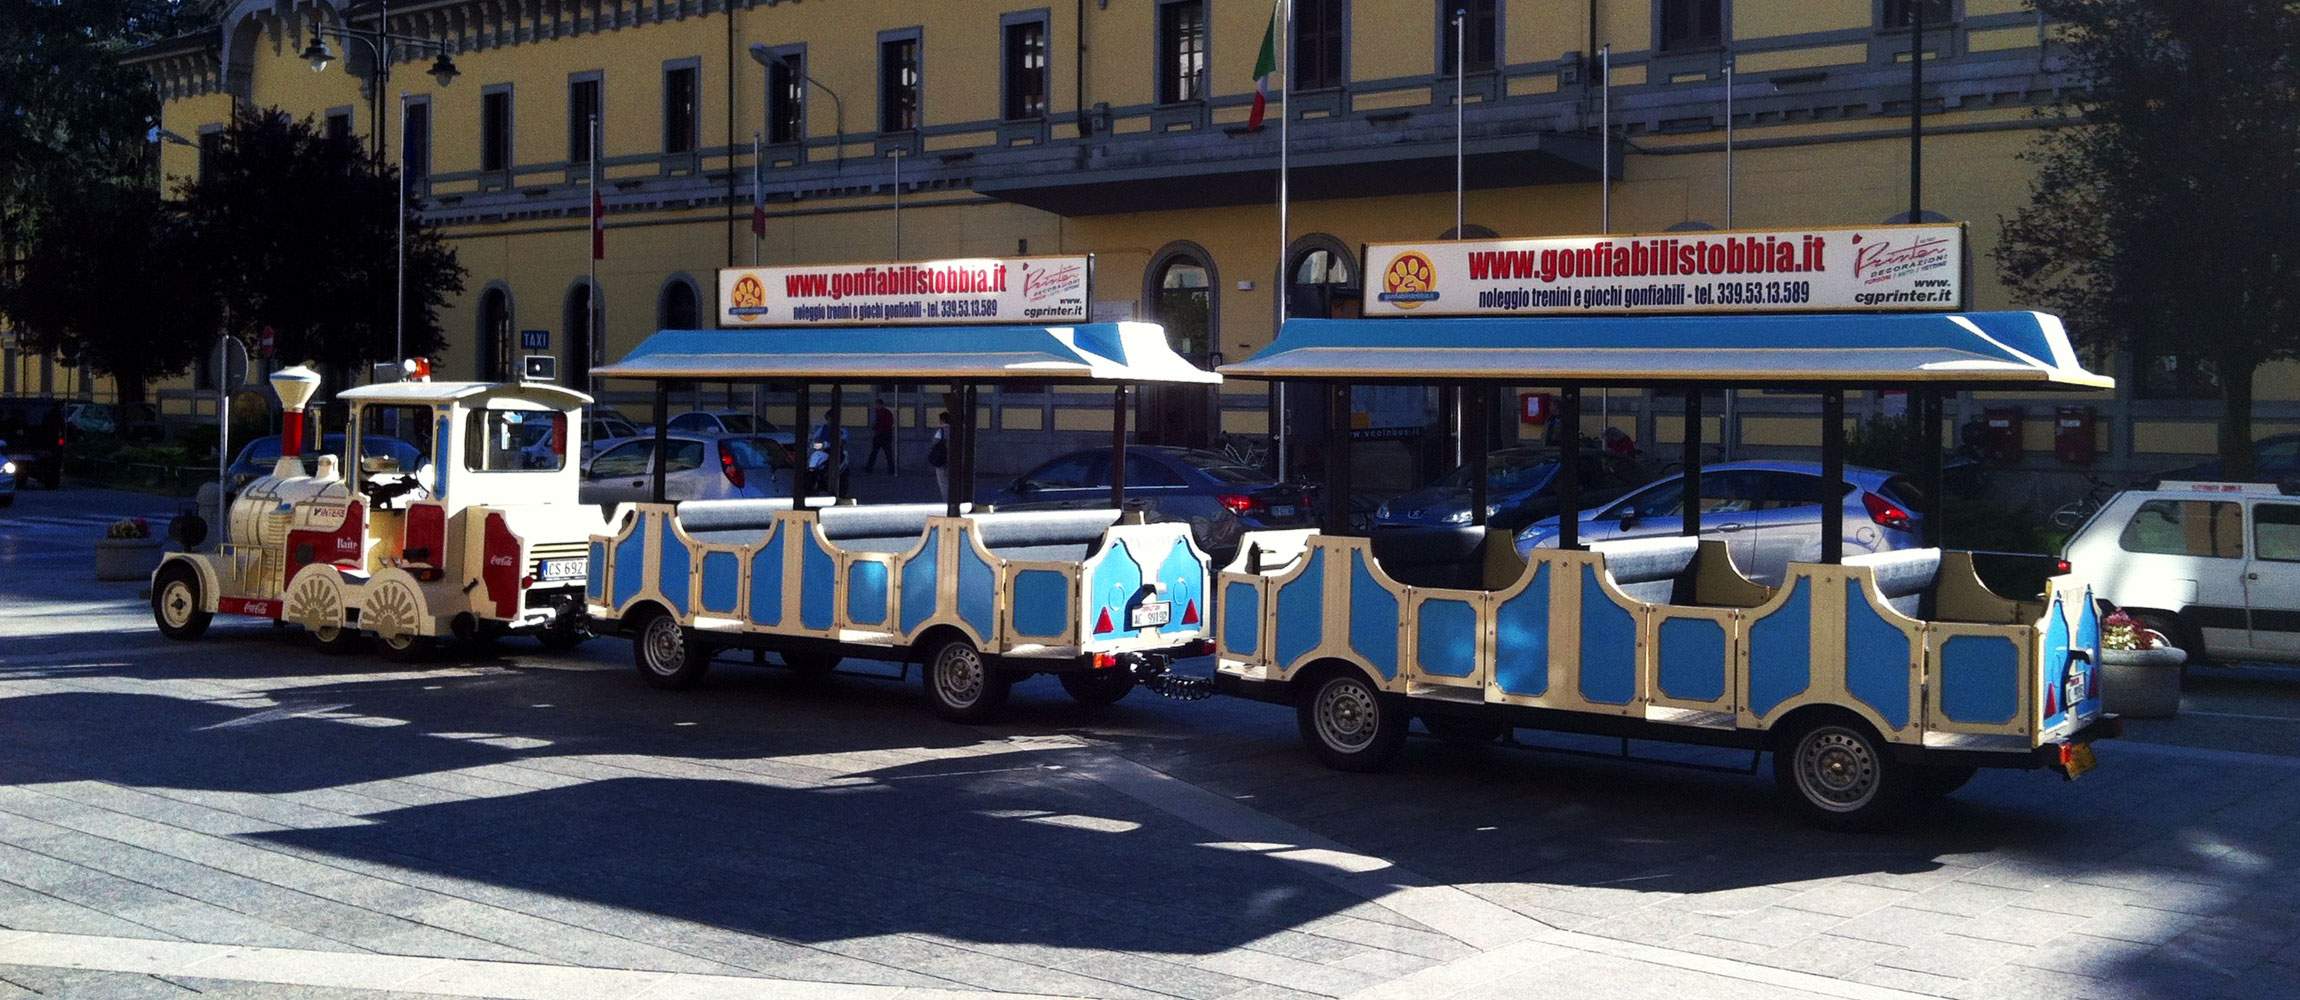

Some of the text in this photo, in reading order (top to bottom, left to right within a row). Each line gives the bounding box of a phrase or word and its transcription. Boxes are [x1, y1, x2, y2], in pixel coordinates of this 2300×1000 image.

[1468, 235, 1826, 282] www.gonfiabilistobbia.it
[1853, 234, 1949, 278] Printer
[785, 263, 1007, 300] www.gonfiabilistobbia.it
[1914, 280, 1951, 288] www.
[1479, 287, 1530, 310] noleggio
[1532, 286, 1572, 307] trenini
[1574, 288, 1582, 307] e
[1584, 285, 1623, 309] giochi
[1624, 283, 1685, 308] gonfiabili
[1694, 283, 1715, 305] tel.
[1717, 281, 1810, 305] 339.53.13.589
[1855, 290, 1952, 305] cgprinter.it
[793, 303, 825, 321] noleggio
[827, 302, 852, 319] trenini
[853, 305, 858, 319] e
[860, 302, 883, 321] giochi
[884, 301, 922, 320] gonfiabili
[927, 301, 940, 318] tel.
[941, 299, 997, 318] 339.53.13.589
[1024, 306, 1083, 318] cgprinter.it
[523, 332, 546, 347] TAXI
[549, 560, 588, 576] CS 692
